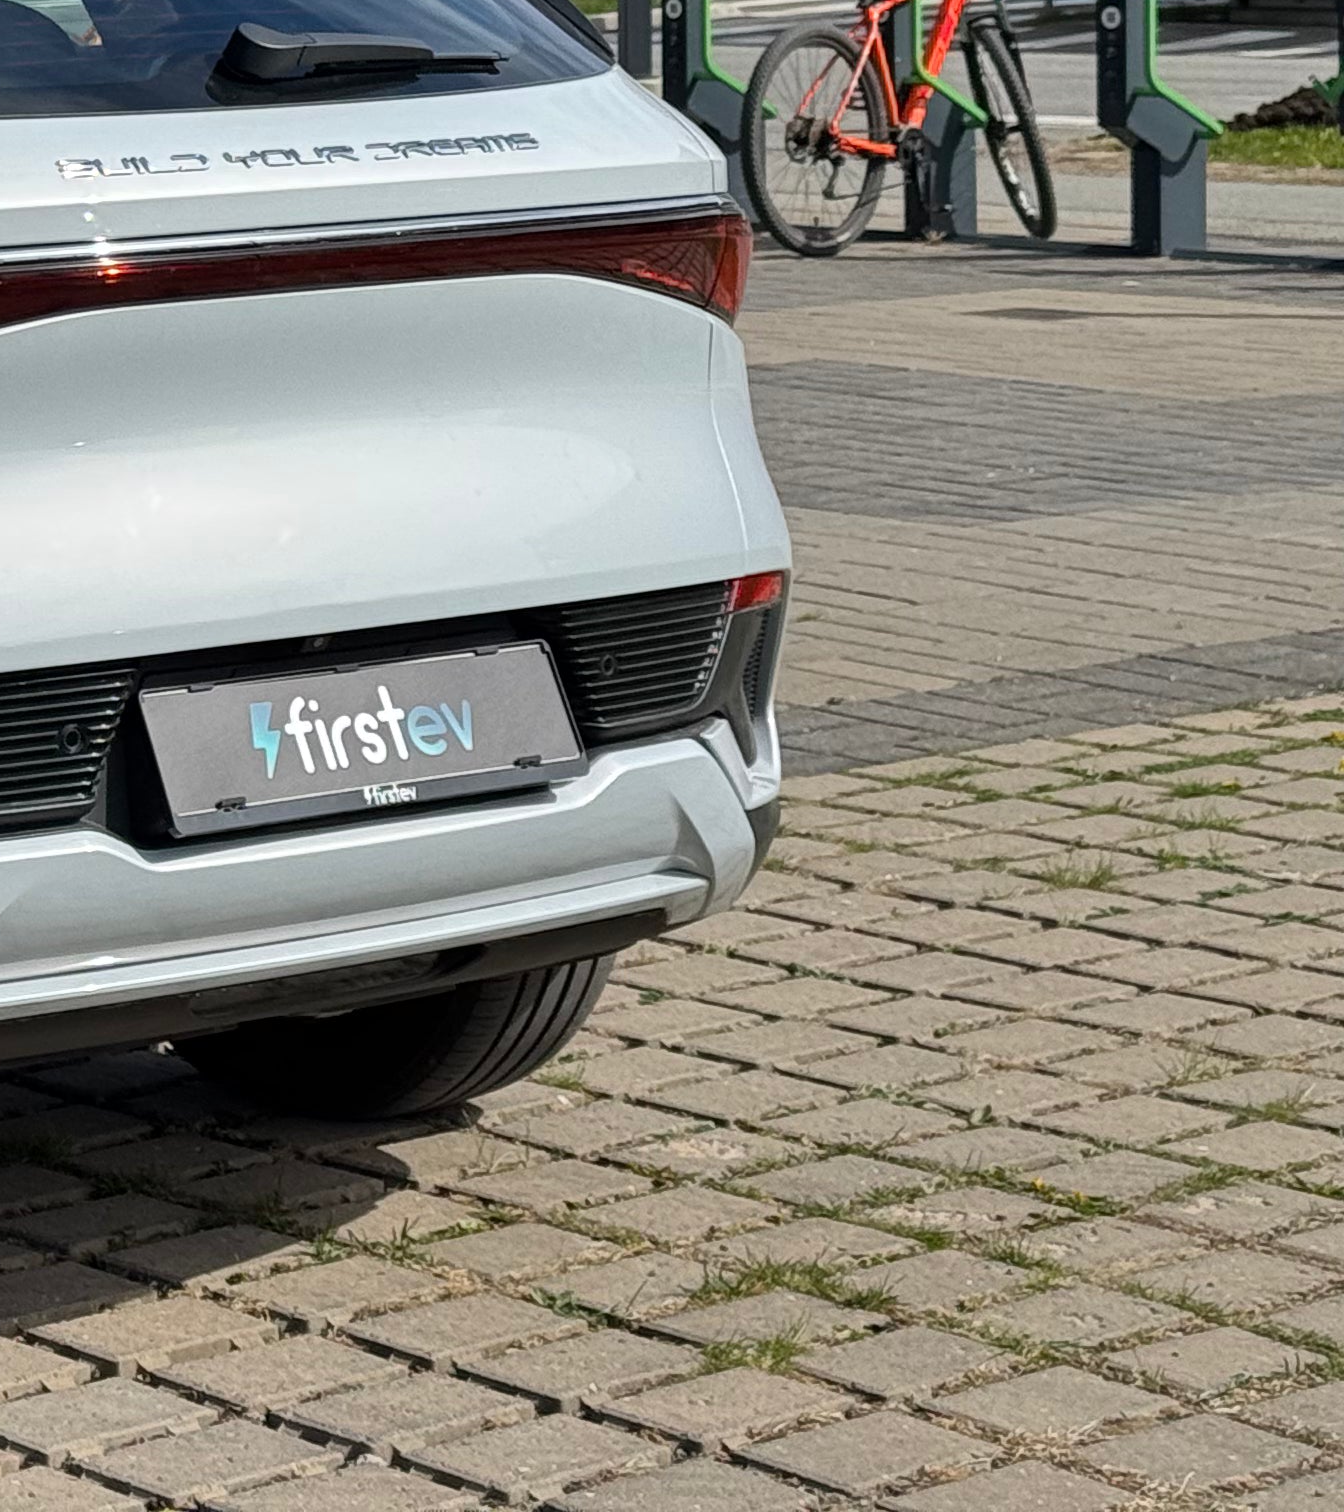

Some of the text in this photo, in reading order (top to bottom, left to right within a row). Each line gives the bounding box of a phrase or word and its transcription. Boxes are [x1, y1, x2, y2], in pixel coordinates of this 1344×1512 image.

[223, 143, 360, 169] YOUR
[365, 131, 541, 161] DREAMS
[284, 684, 474, 775] firstev
